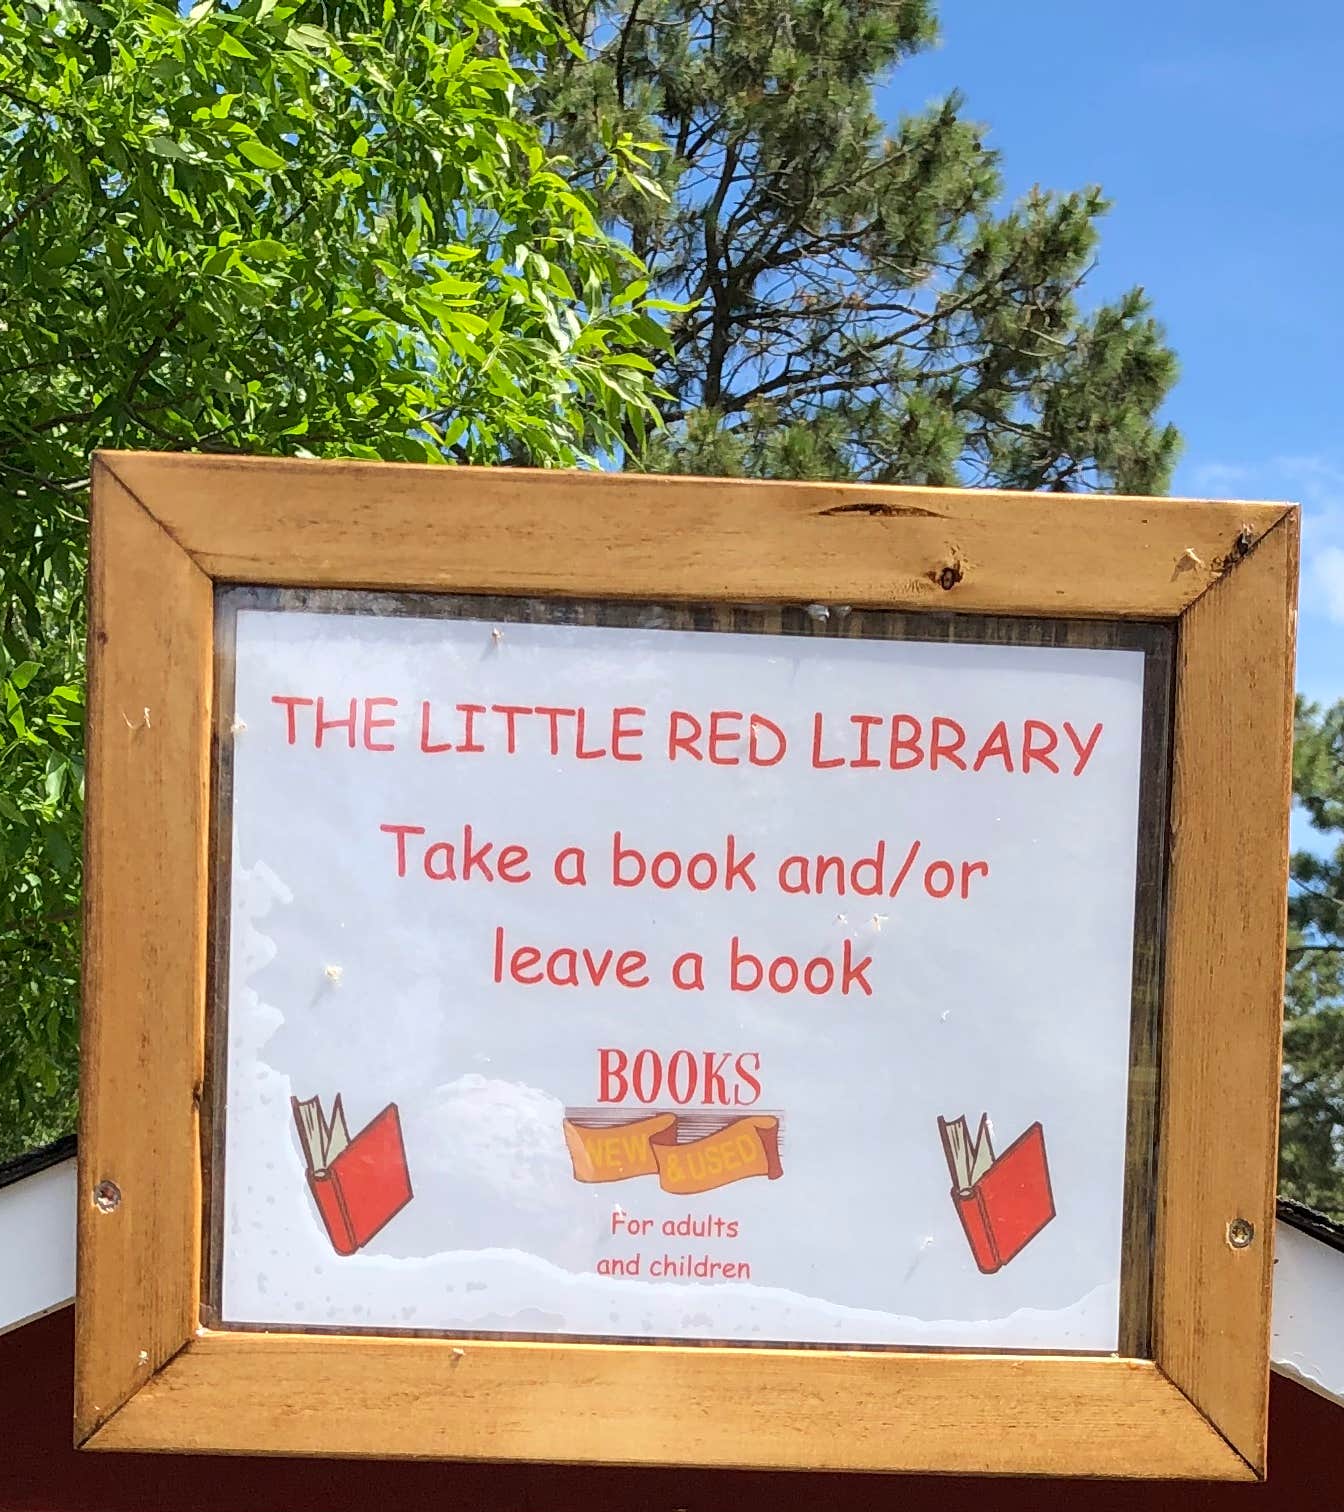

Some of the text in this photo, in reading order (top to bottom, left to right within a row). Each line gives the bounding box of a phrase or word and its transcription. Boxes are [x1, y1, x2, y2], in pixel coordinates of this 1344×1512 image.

[271, 694, 1104, 777] THE LITTLE RED LIBRARY
[380, 823, 990, 901] Take a book and/or
[492, 926, 873, 997] leave a book
[597, 1047, 762, 1106] BOOKS
[586, 1133, 757, 1184] NEW & USED
[611, 1210, 739, 1239] For adults
[596, 1253, 751, 1280] and children
